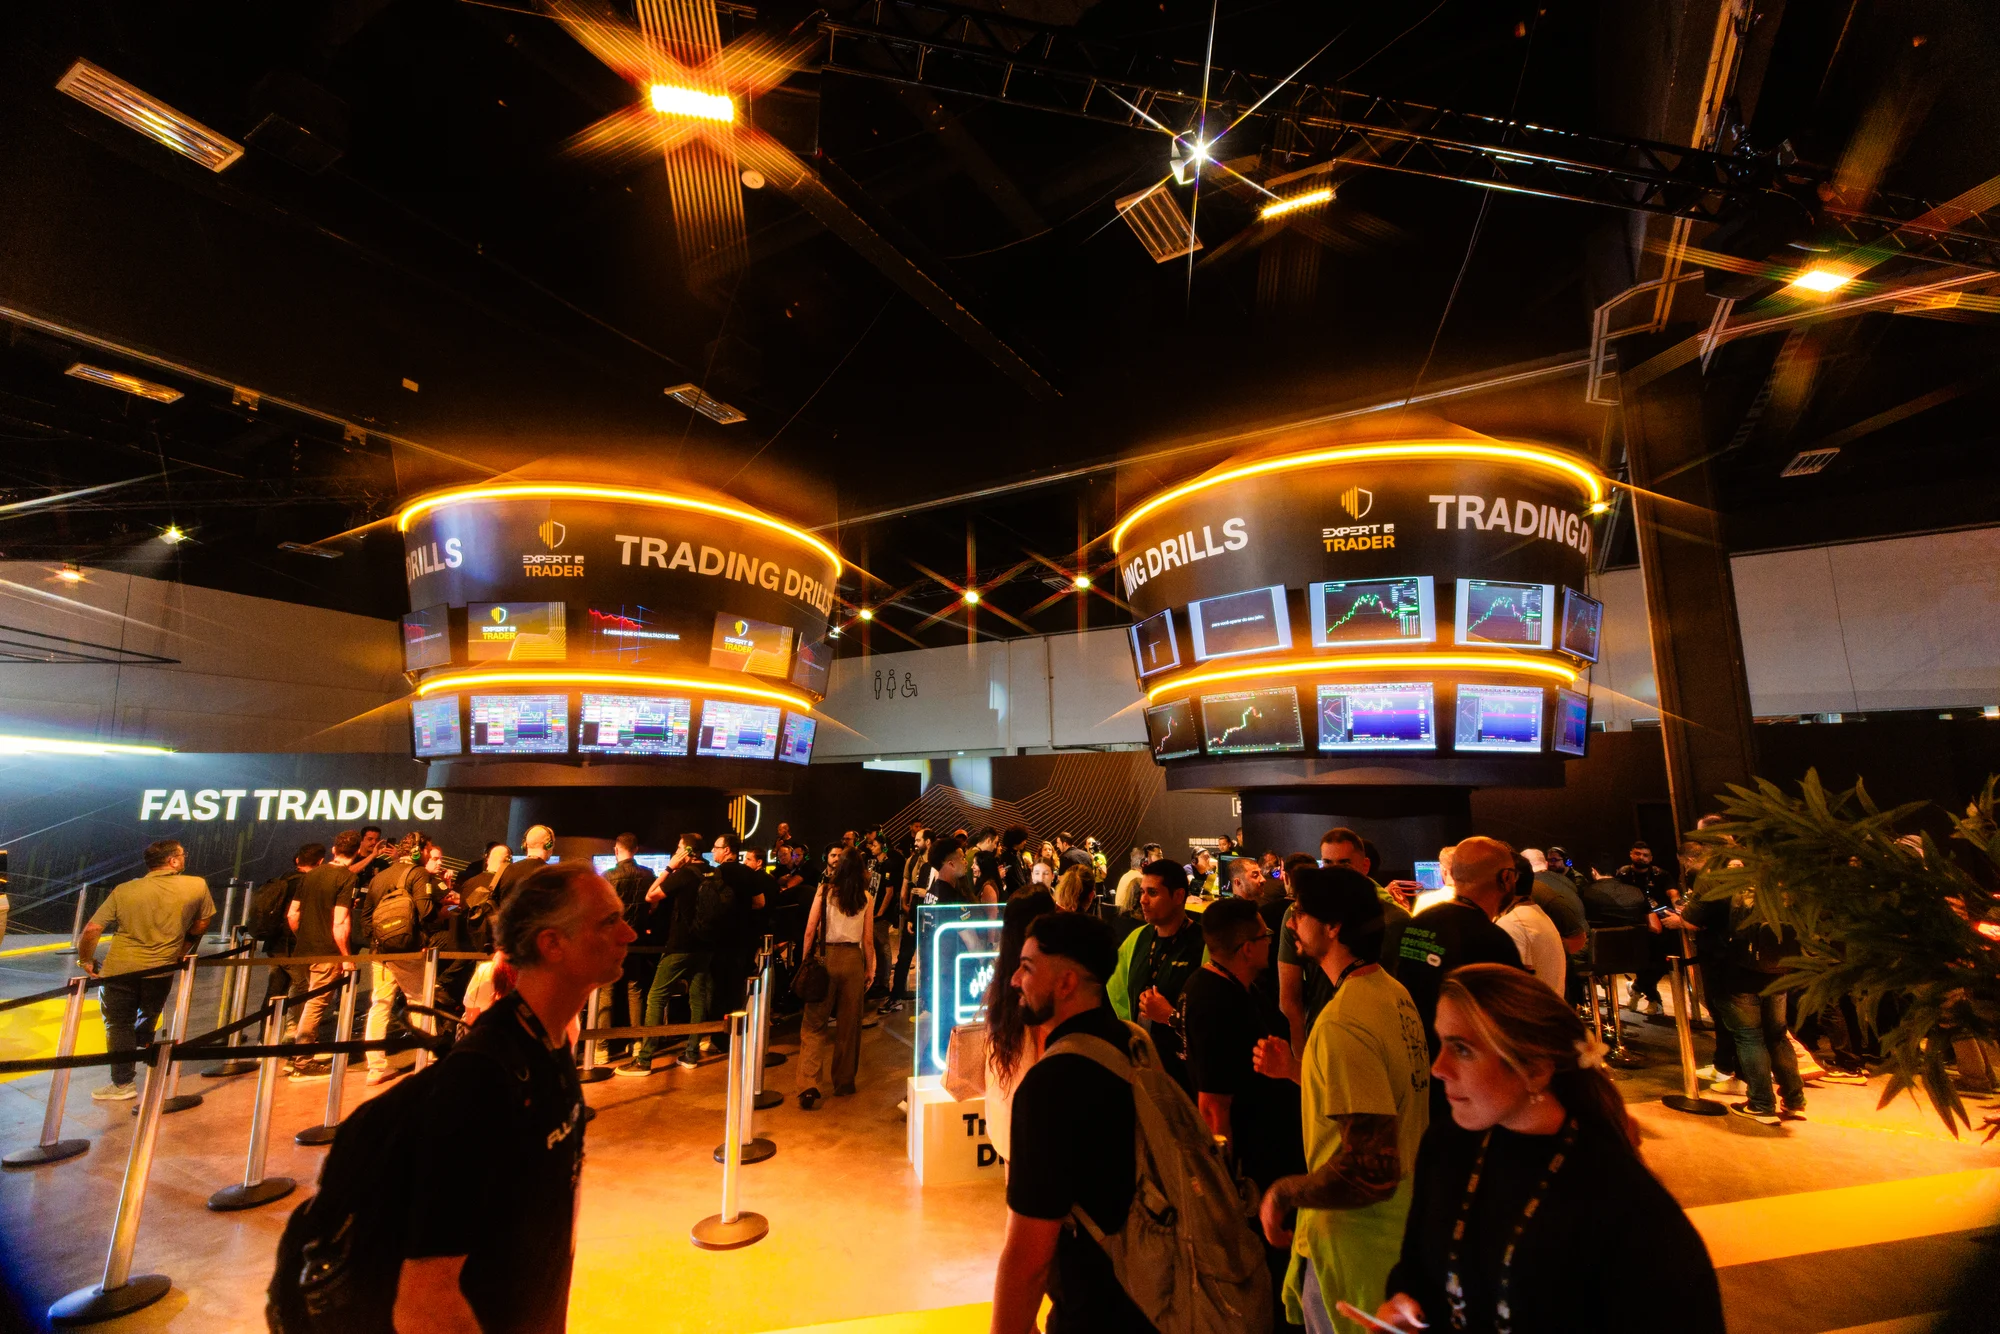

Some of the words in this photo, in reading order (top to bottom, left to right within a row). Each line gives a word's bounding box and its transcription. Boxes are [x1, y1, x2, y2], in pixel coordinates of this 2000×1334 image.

[1429, 494, 1580, 549] TRADING
[1322, 524, 1380, 538] EXPERT
[1145, 517, 1249, 578] DRILLS
[1322, 535, 1396, 553] TRADER
[406, 537, 463, 585] DRILLS
[522, 554, 572, 564] EXPERT
[523, 564, 585, 577] TRADER
[614, 534, 780, 591] TRADING
[783, 567, 833, 617] DRILLS
[483, 632, 516, 640] TRADER
[639, 631, 666, 639] RESULTADO
[724, 642, 753, 654] TRADER
[140, 789, 247, 821] FAST
[253, 789, 444, 821] TRADING
